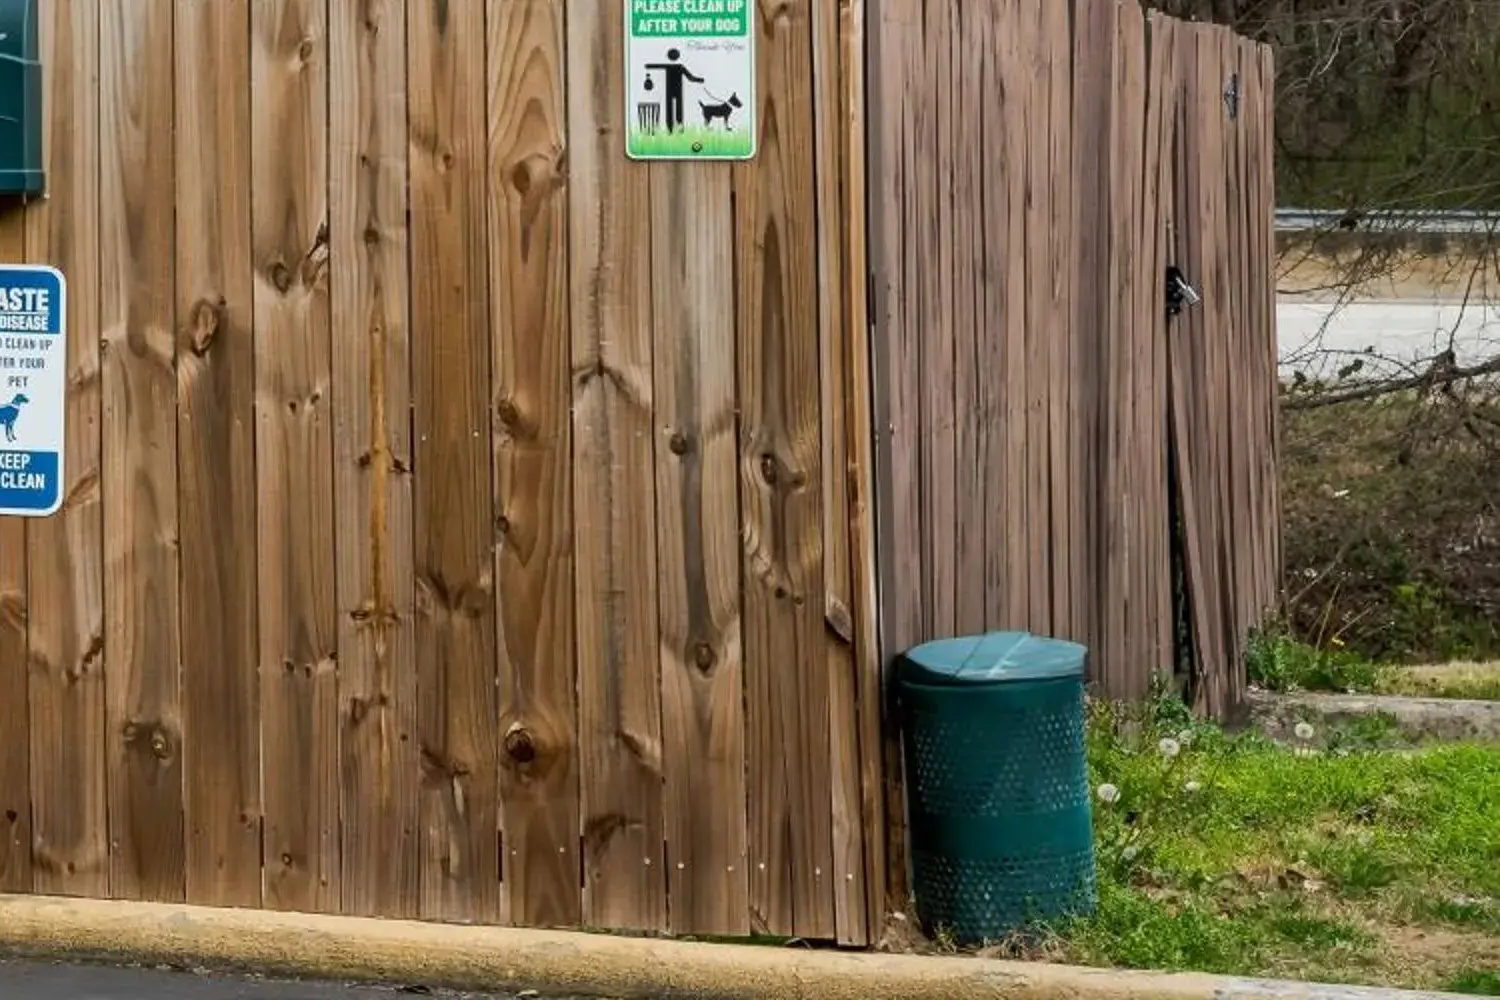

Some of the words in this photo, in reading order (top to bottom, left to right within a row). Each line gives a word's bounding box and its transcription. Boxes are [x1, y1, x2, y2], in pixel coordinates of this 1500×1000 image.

[634, 0, 680, 13] PLEASE
[684, 0, 724, 13] CLEAN
[727, 0, 744, 13] UP
[638, 19, 677, 32] AFTER
[681, 19, 712, 33] YOUR
[715, 19, 740, 32] DOG
[5, 338, 36, 350] CLEAN
[39, 339, 52, 350] UP
[19, 357, 45, 369] YOUR
[8, 376, 29, 388] PET
[0, 472, 45, 489] CLEAN
